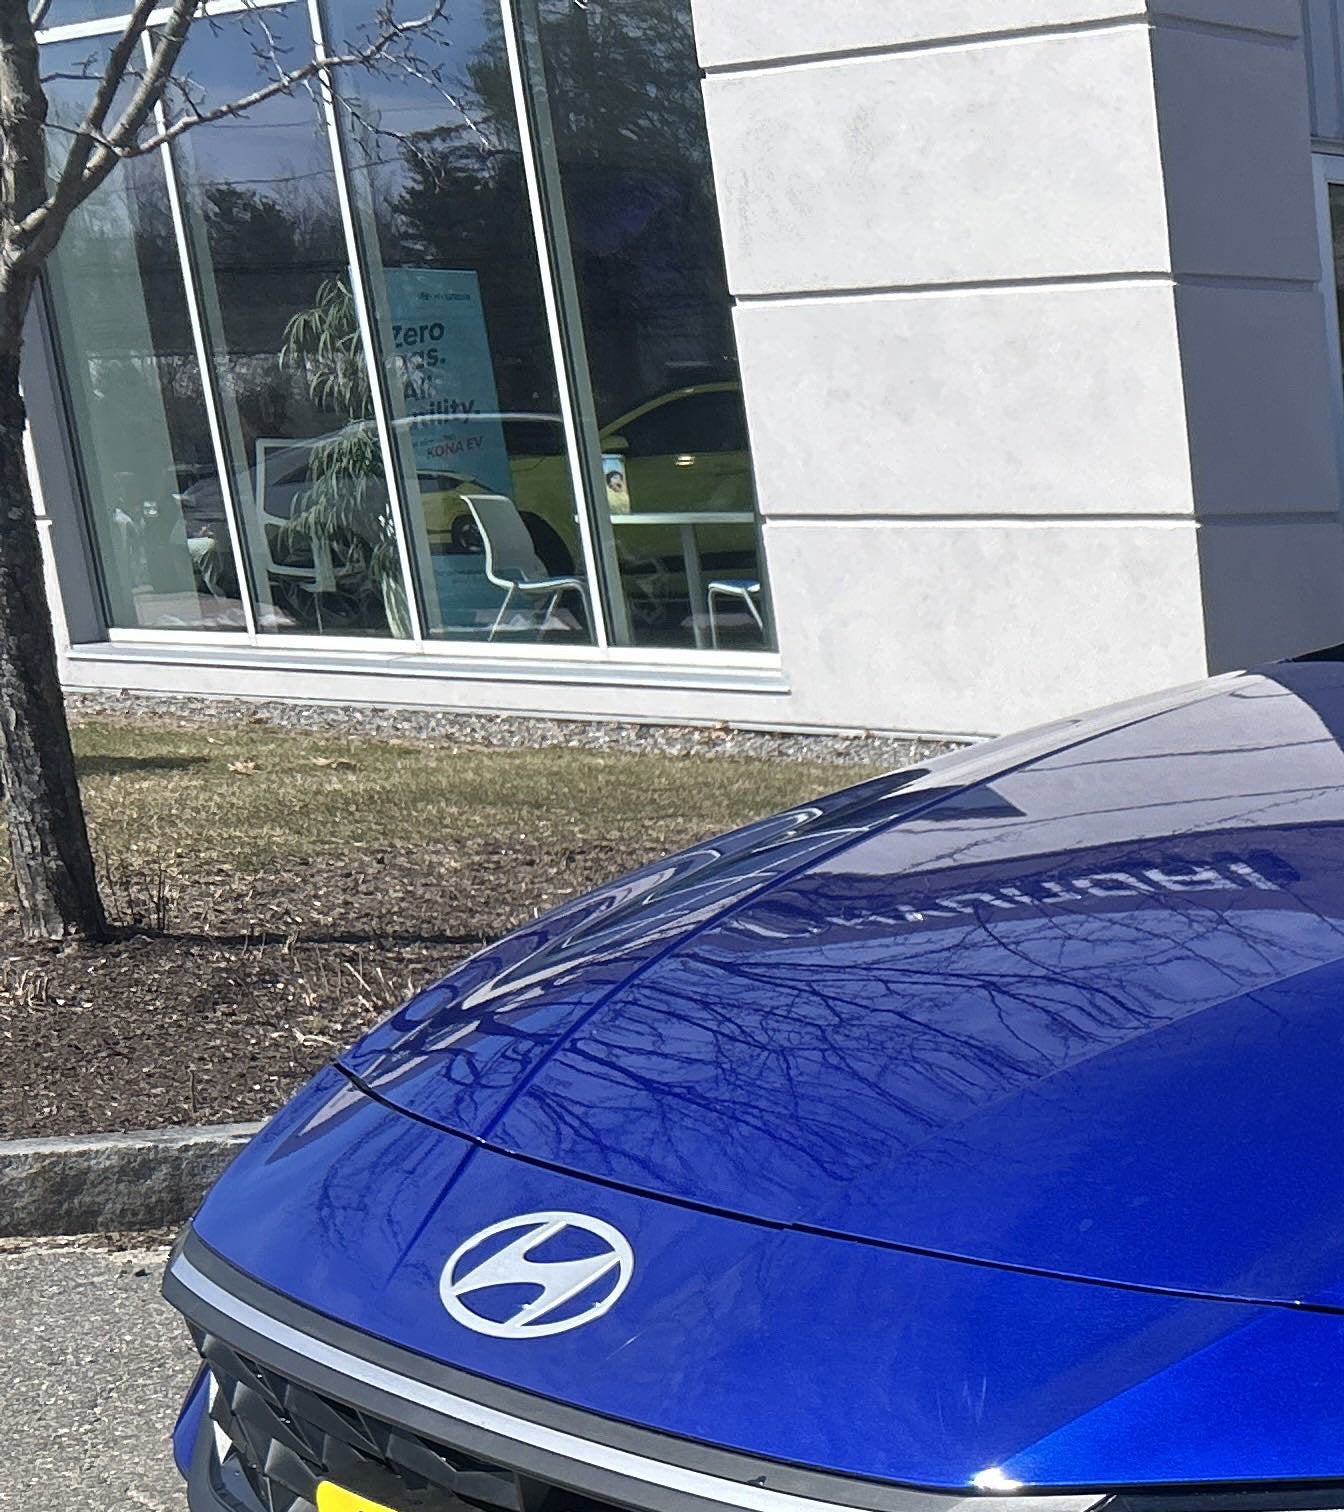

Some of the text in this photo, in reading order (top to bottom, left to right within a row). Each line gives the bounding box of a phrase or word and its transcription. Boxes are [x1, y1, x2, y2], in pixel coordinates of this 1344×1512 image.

[392, 322, 445, 348] Zero
[426, 440, 465, 458] KONA
[466, 435, 484, 450] EV
